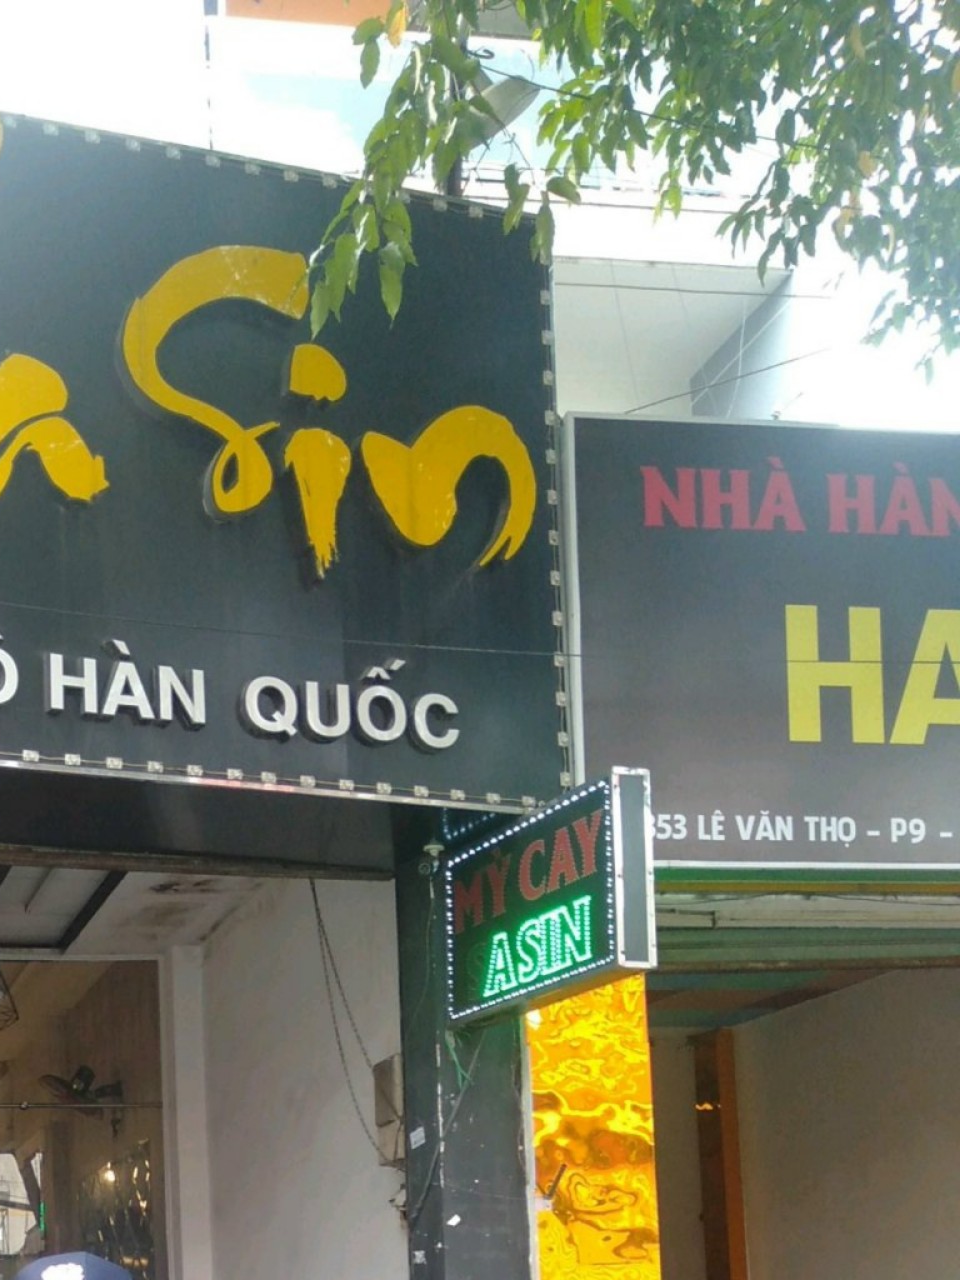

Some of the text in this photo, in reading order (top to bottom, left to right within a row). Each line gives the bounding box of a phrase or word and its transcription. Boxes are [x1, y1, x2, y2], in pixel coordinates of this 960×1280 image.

[640, 456, 807, 531] NHÀ
[50, 639, 207, 726] HÀN
[245, 660, 460, 748] QUỐC
[518, 808, 603, 901] CAY
[697, 810, 726, 841] LÊ
[735, 810, 794, 842] VĂN
[804, 816, 857, 848] THỌ
[890, 817, 927, 844] P9
